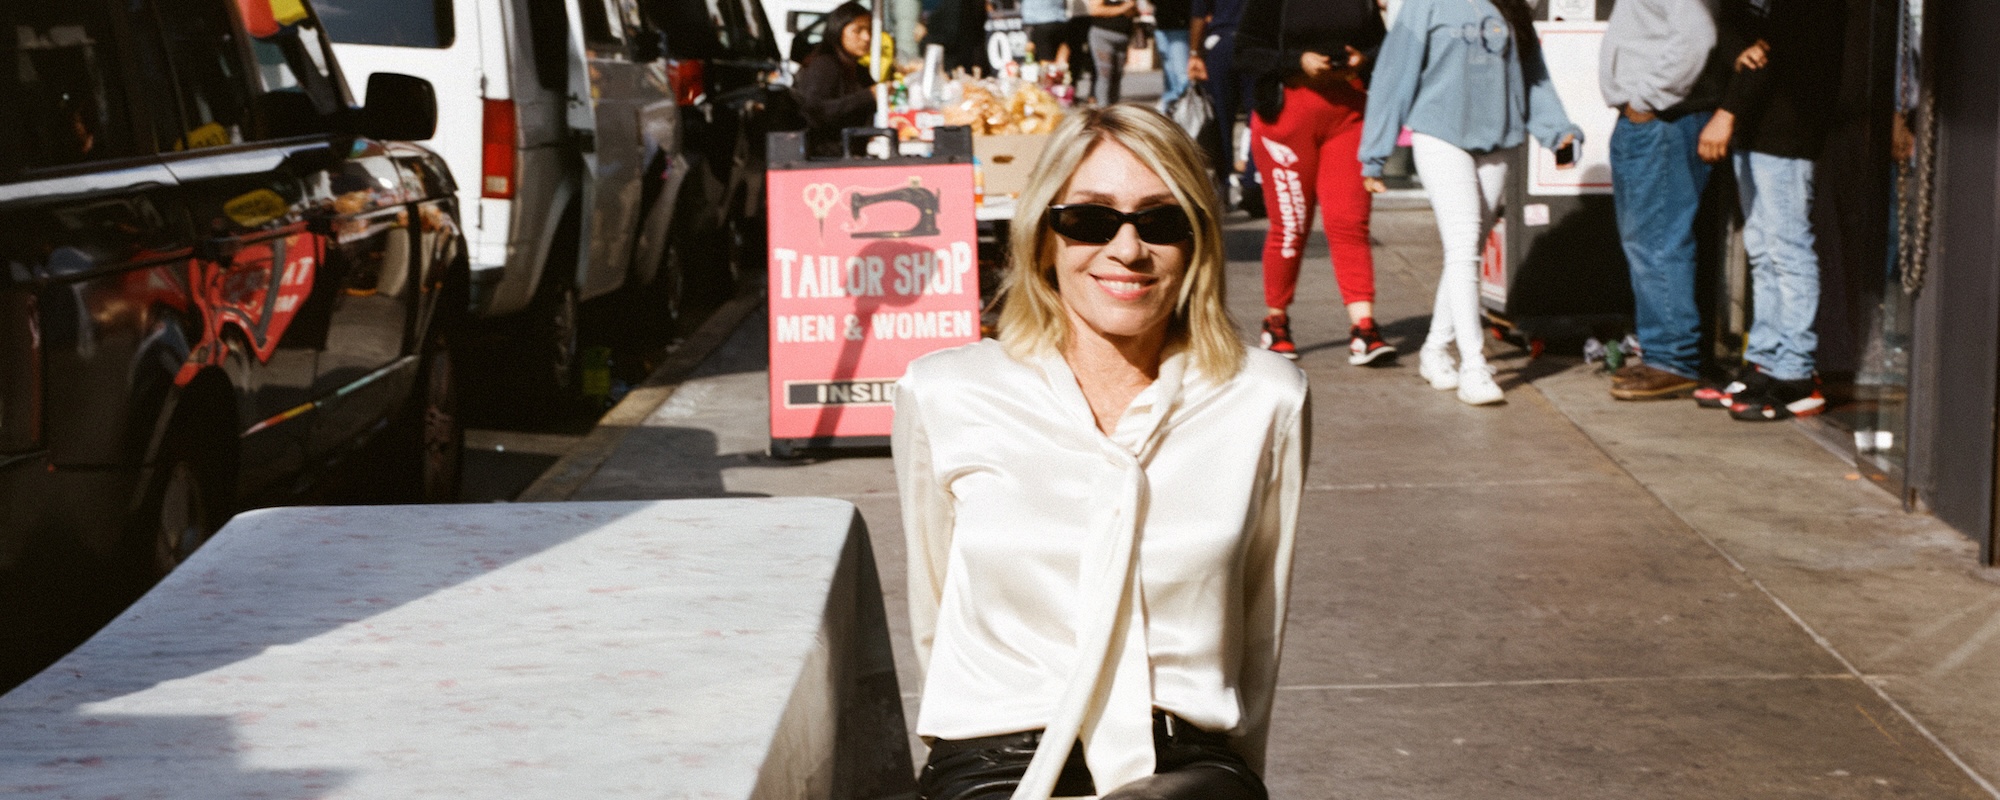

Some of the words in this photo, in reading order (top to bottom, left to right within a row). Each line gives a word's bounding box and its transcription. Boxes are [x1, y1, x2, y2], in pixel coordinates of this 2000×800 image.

[774, 248, 885, 298] TAILOR
[893, 241, 972, 295] SHOP
[776, 314, 836, 343] MEN
[843, 313, 864, 341] &
[871, 310, 973, 340] WOMEN
[817, 382, 897, 404] INSID
